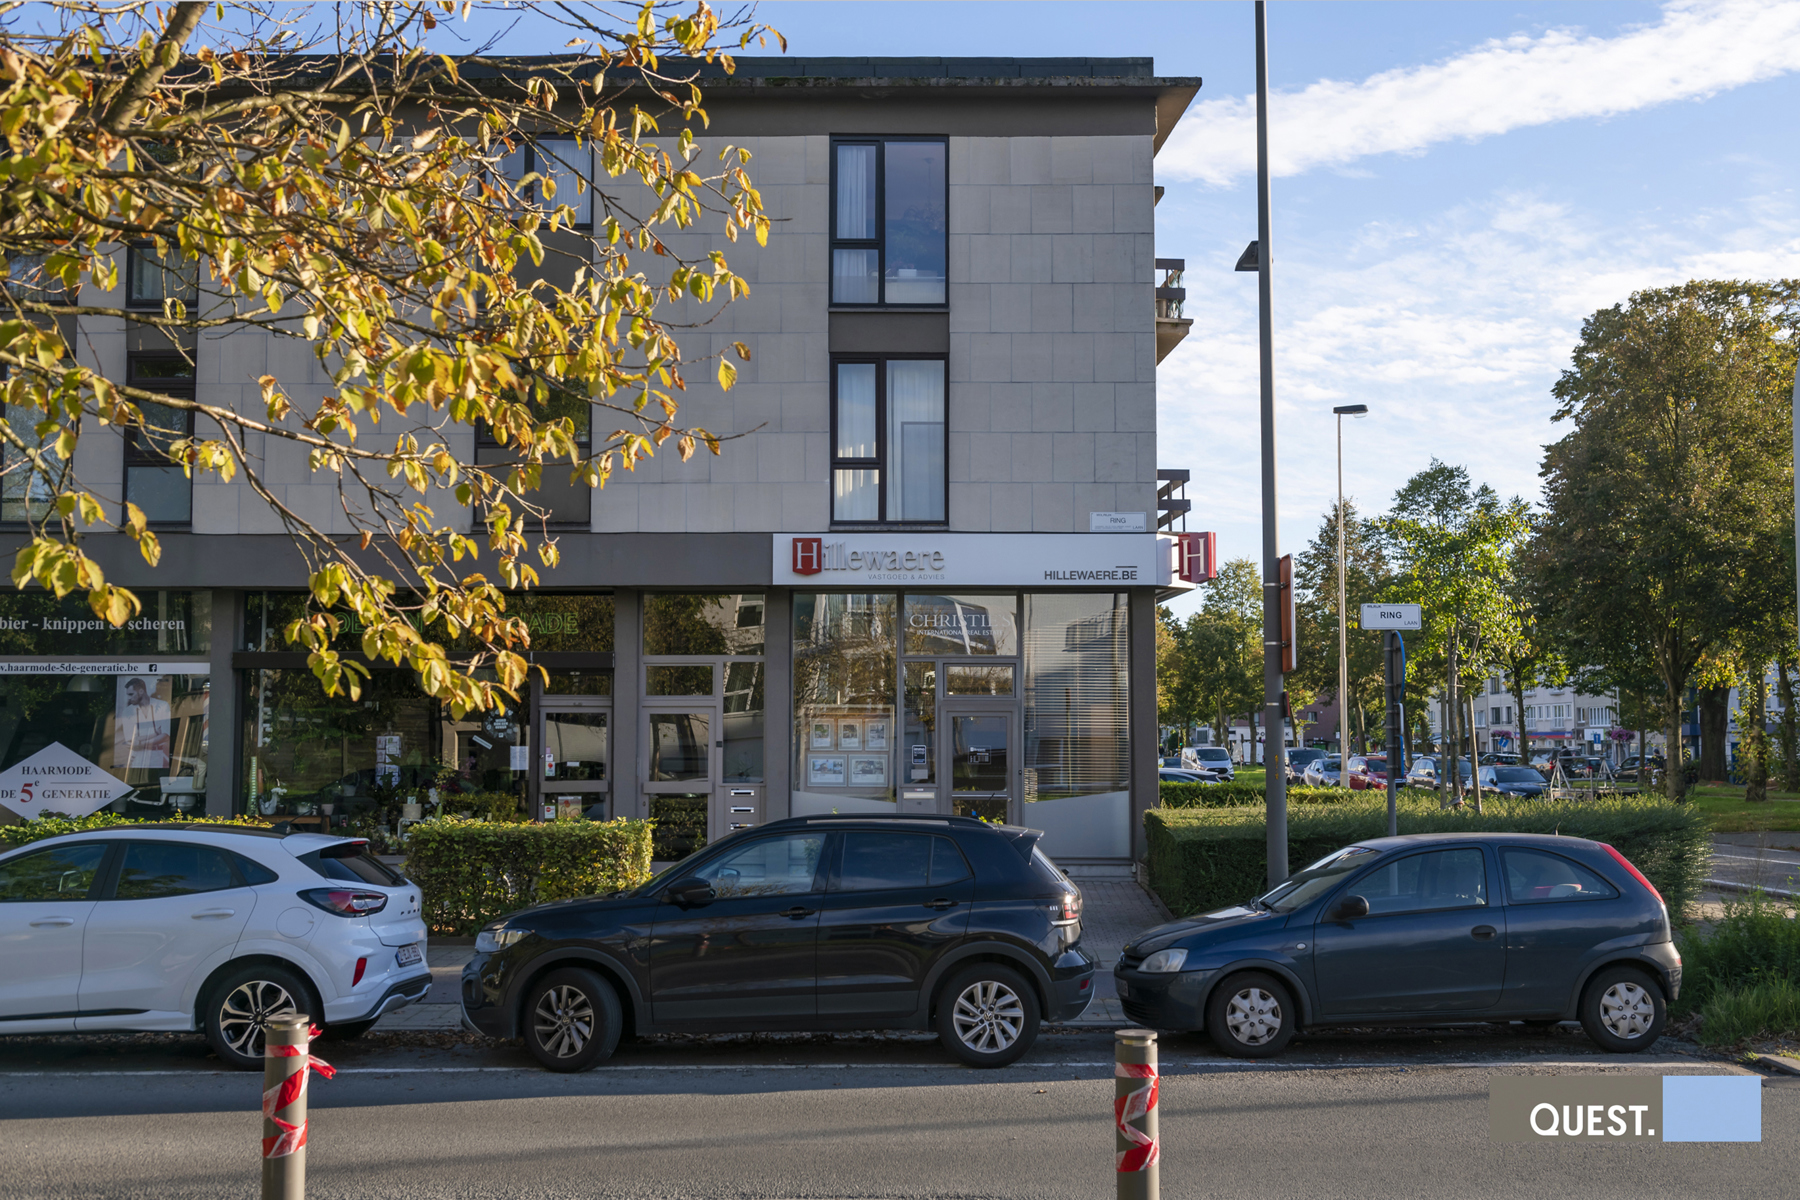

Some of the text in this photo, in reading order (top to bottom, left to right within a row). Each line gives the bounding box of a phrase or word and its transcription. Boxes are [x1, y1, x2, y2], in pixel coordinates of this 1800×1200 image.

[796, 541, 944, 571] Hillewaere
[1182, 538, 1206, 576] H
[1044, 570, 1138, 580] HILLEWAERE.BE
[1380, 611, 1402, 619] RING
[43, 616, 104, 633] knippen
[128, 617, 185, 630] scheren
[22, 766, 92, 775] HAARMODE
[1, 789, 16, 798] DE
[42, 789, 111, 799] GENERATIE
